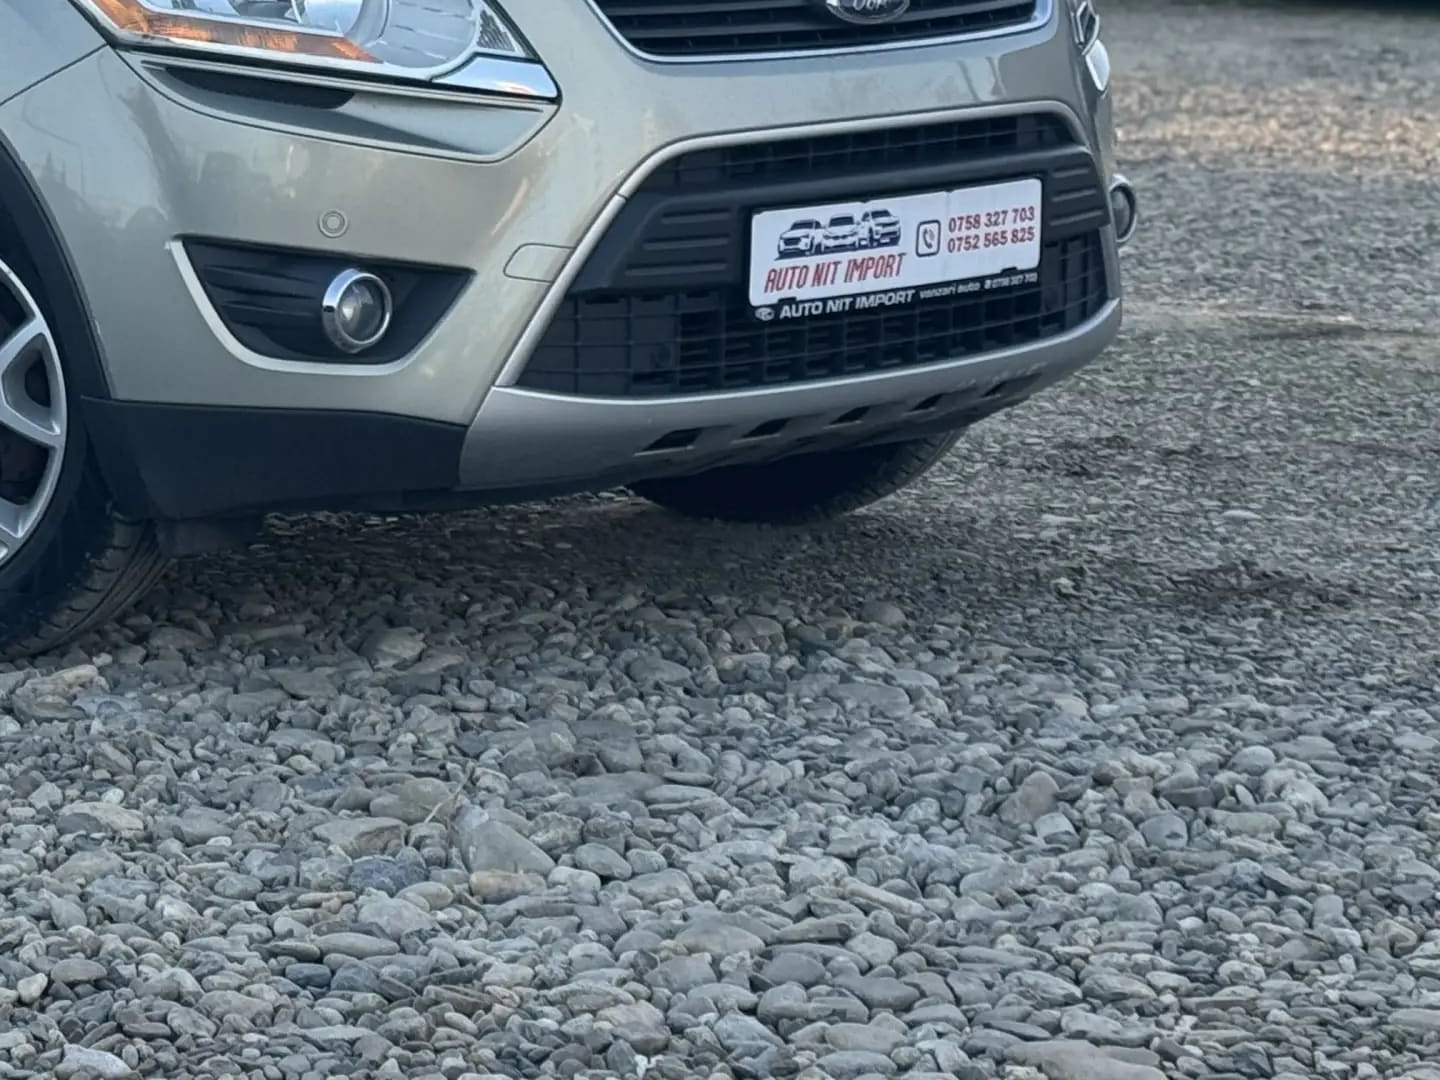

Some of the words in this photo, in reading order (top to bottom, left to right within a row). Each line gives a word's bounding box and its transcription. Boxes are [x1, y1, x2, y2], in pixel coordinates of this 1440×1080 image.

[949, 214, 980, 233] 0758
[984, 210, 1008, 228] 327
[1012, 205, 1035, 224] 703
[948, 234, 980, 253] 0752
[984, 230, 1008, 248] 565
[1011, 226, 1035, 244] 825
[764, 265, 810, 294] AUTO
[811, 261, 842, 288] NIT
[844, 252, 907, 283] IMPORT
[780, 301, 823, 319] AUTO
[826, 298, 853, 314] NIT
[855, 289, 915, 309] IMPORT
